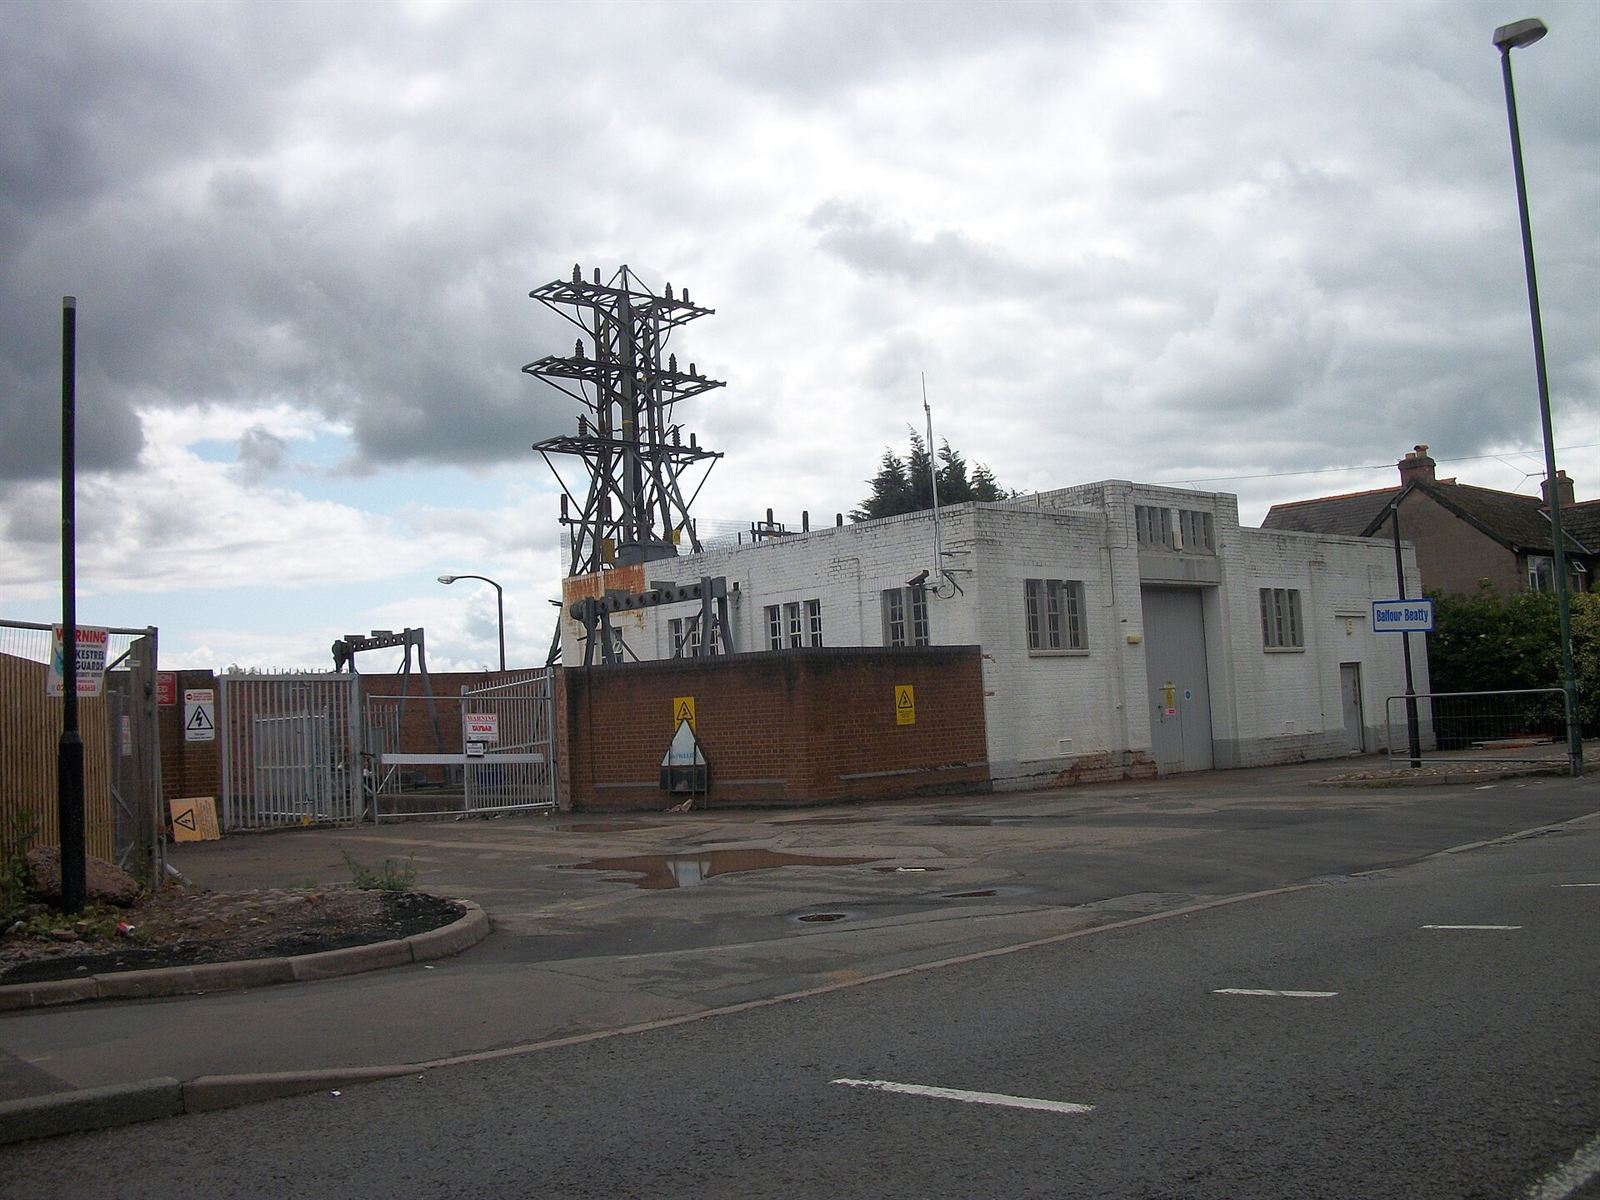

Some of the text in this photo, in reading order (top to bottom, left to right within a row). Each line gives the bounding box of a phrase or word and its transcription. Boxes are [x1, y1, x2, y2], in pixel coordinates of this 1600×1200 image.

[1376, 608, 1428, 623] Balfour Beatty
[55, 628, 107, 643] WRNING
[76, 649, 104, 660] KESTREL
[76, 660, 104, 671] GUARDS
